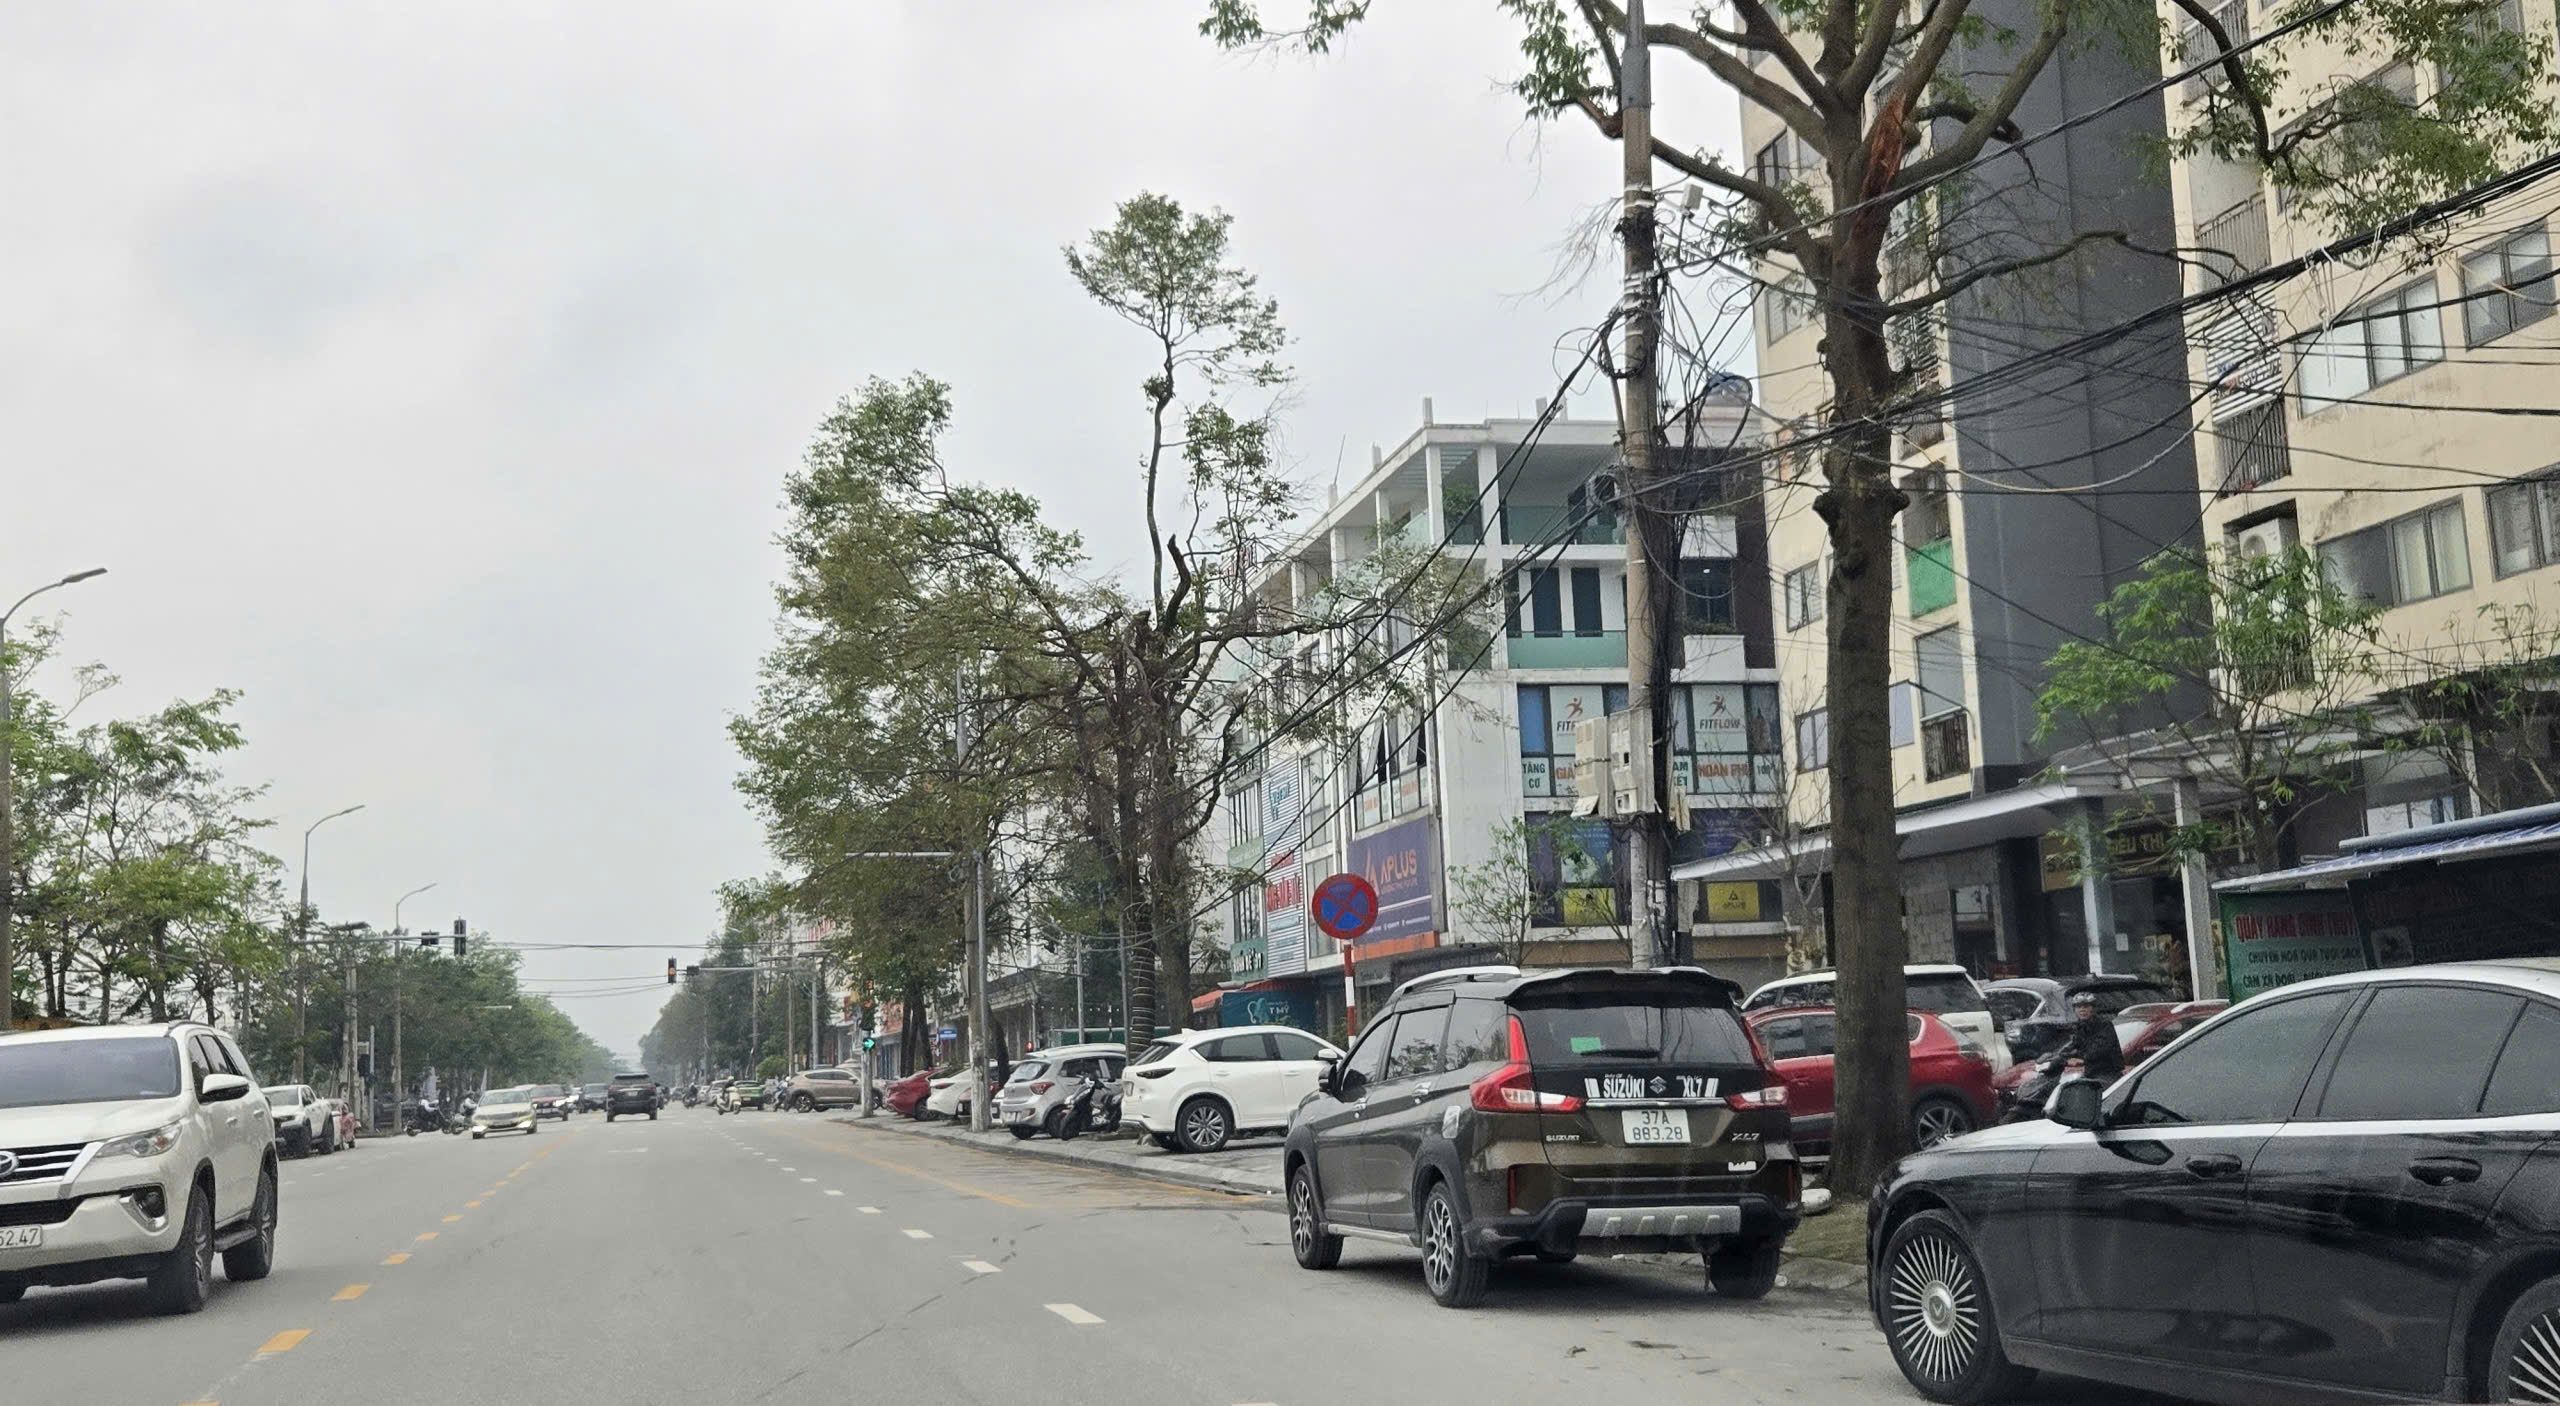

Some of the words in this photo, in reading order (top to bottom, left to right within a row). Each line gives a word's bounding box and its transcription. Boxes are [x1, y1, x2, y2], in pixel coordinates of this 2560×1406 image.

[1556, 720, 1576, 732] FITF
[1379, 848, 1418, 885] APLUS
[1603, 1077, 1645, 1098] SUZUKI
[1682, 1077, 1703, 1098] XL7
[1641, 1111, 1670, 1125] 37A
[1545, 1134, 1580, 1142] SUZUKI
[1633, 1126, 1683, 1141] 883.28
[1731, 1132, 1760, 1142] XL7
